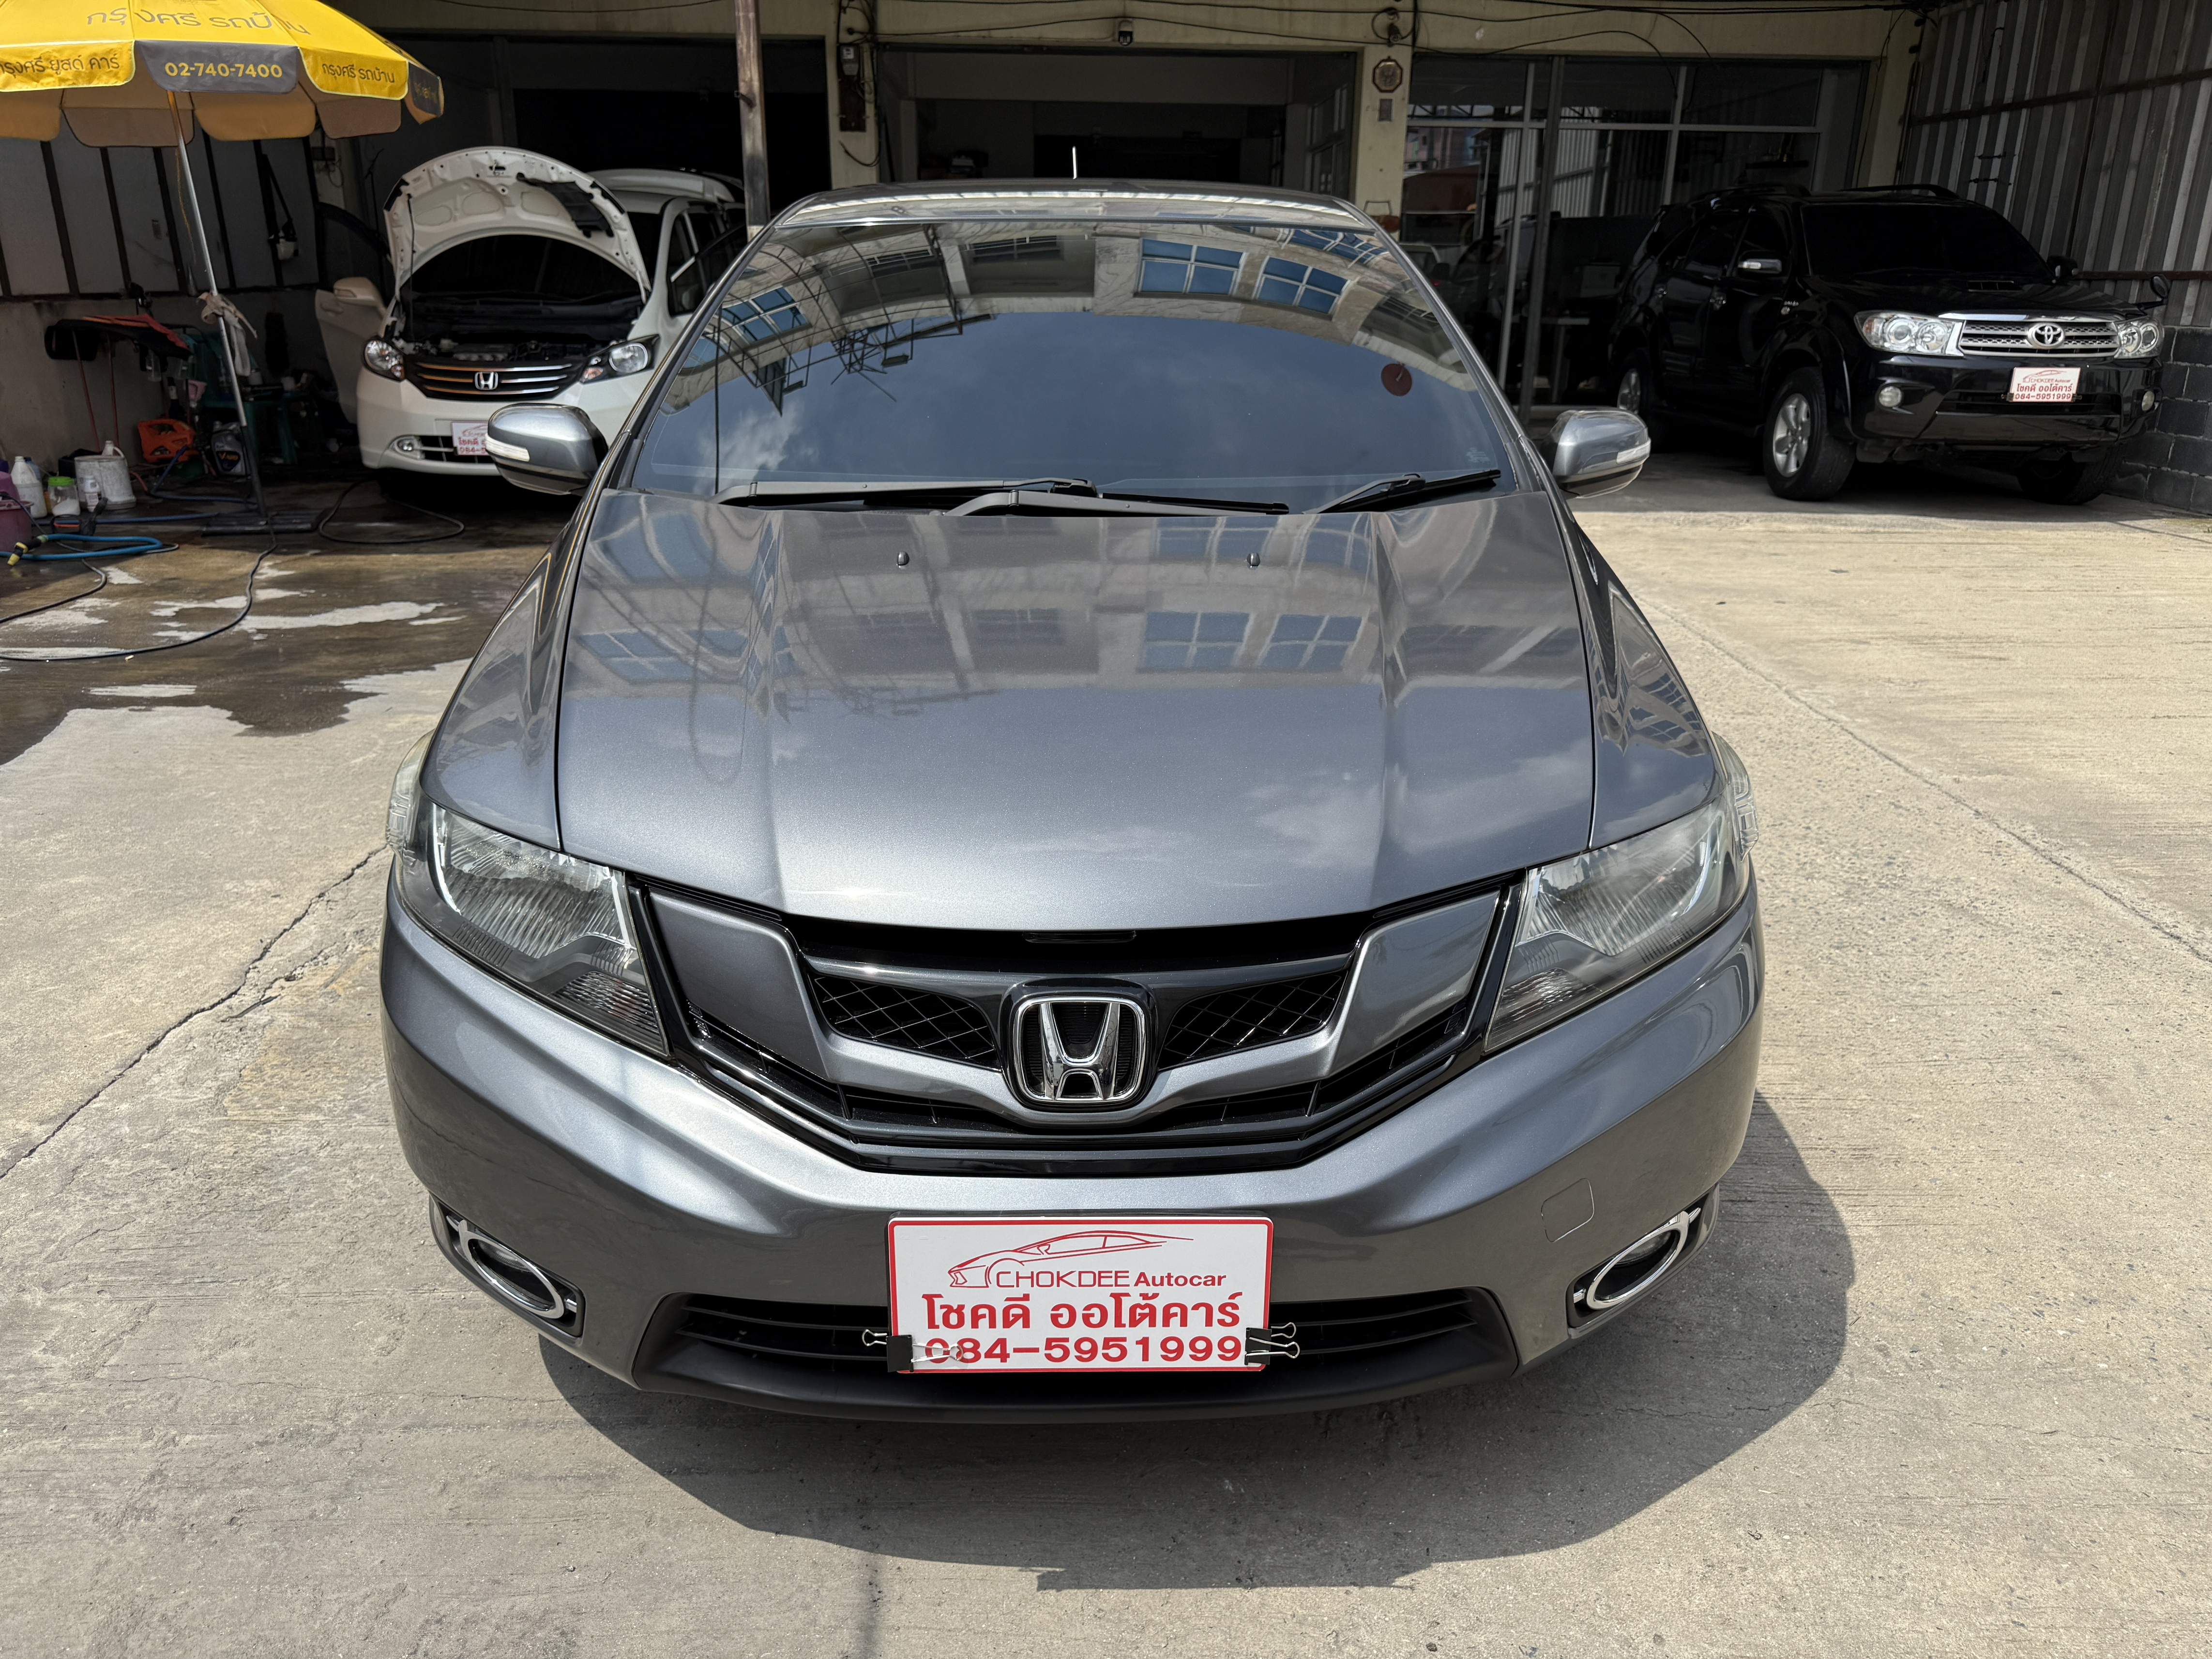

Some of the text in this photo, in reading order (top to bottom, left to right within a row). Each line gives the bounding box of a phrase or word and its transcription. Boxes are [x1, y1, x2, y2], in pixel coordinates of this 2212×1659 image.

[87, 7, 201, 27] กรุงศรี
[50, 55, 84, 76] ยูสด์
[89, 53, 120, 70] คาร์
[165, 62, 283, 78] 02-740-7400
[322, 63, 395, 83] กรุงศรี รถบ้าน
[2016, 383, 2036, 392] โชคดี
[995, 1270, 1227, 1288] CHOKDEE Autocar
[922, 1291, 1243, 1330] โชคดี ออโต้คาร์
[924, 1335, 1243, 1364] 084-5951999
